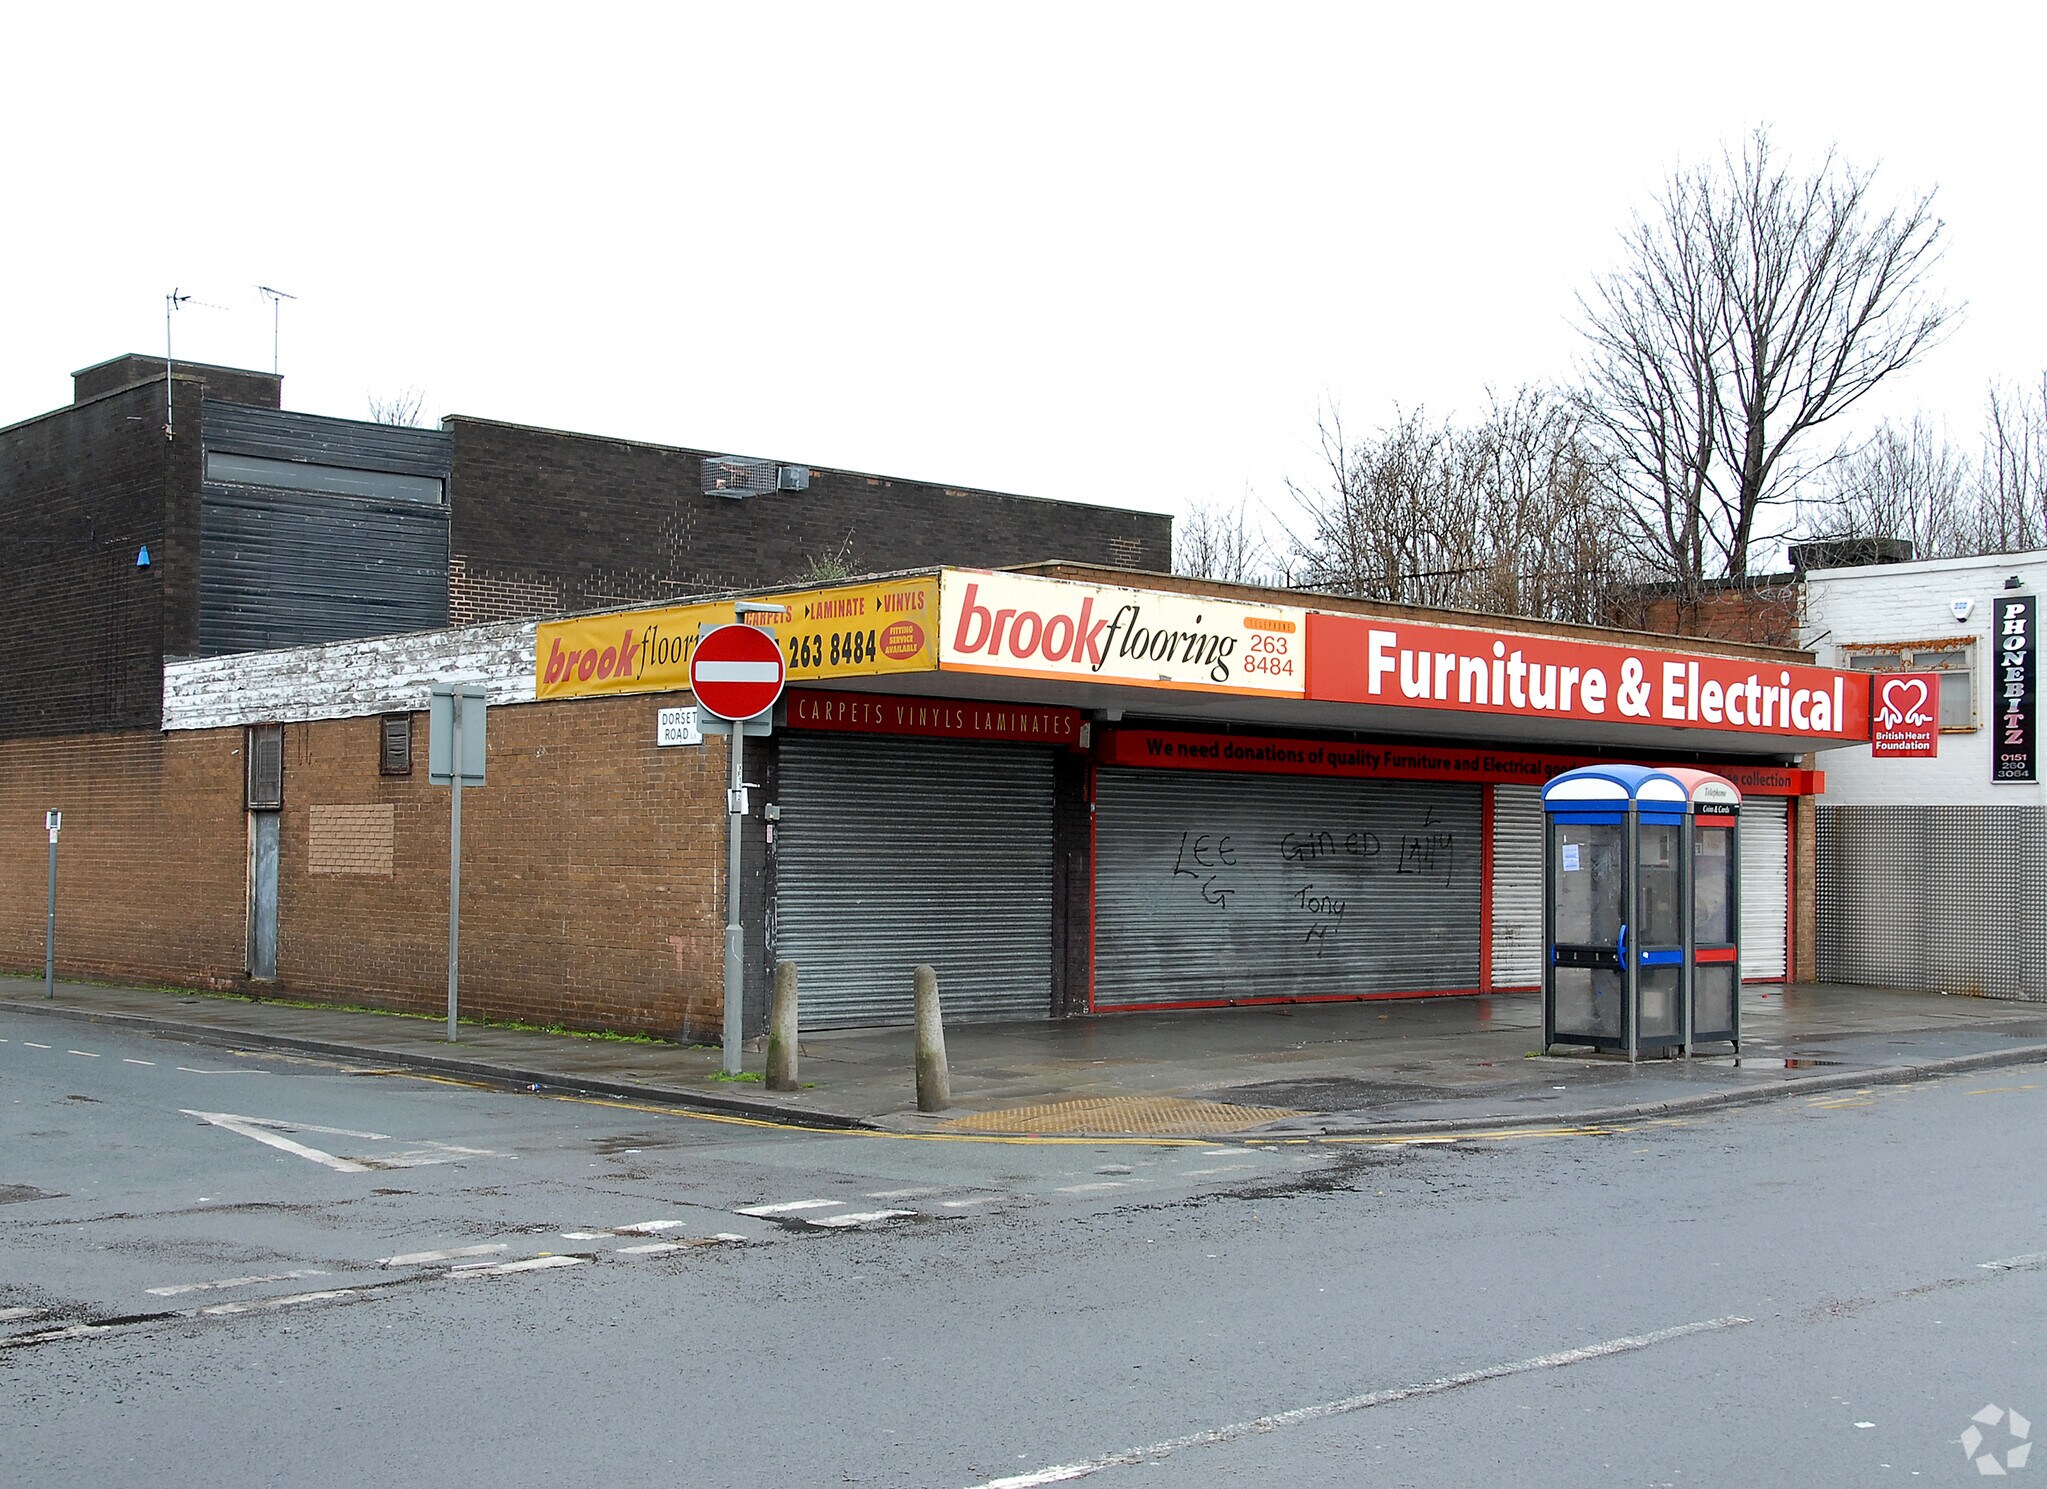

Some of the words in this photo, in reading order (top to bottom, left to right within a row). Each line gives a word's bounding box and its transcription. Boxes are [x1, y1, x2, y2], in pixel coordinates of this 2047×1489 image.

[810, 597, 865, 620] LAMINATE
[884, 591, 925, 613] VINYLS
[889, 635, 914, 645] SERVICE
[954, 583, 1109, 665] brook
[1092, 605, 1238, 682] flooring
[1250, 634, 1288, 655] 263
[543, 629, 640, 684] brook
[637, 621, 701, 680] floori
[789, 634, 823, 669] 263
[830, 630, 876, 666] 8484
[885, 644, 918, 654] AVAILABLE
[1244, 655, 1294, 676] 8484
[2001, 603, 2027, 745] PHONEBITZ
[1367, 629, 1607, 715] Furniture
[1617, 657, 1652, 719] &
[1662, 661, 1844, 733] Electrical
[662, 712, 697, 725] DORSET
[800, 699, 883, 724] CARPETS
[897, 706, 963, 729] VINYLS
[975, 711, 1071, 735] LAMINATES
[665, 728, 689, 740] ROAD
[1876, 731, 1904, 740] British
[1905, 732, 1930, 740] Heart
[1876, 741, 1930, 750] Foundation
[1147, 737, 1173, 757] We
[1178, 741, 1219, 759] need
[1224, 742, 1304, 765] donations
[1308, 747, 1324, 765] of
[1327, 750, 1380, 771] quality
[1384, 751, 1451, 771] Furniture
[1454, 755, 1480, 772] and
[1484, 756, 1541, 775] Electrical
[1742, 771, 1791, 787] collection
[2001, 753, 2027, 761] 0151
[1174, 831, 1237, 878] LEE
